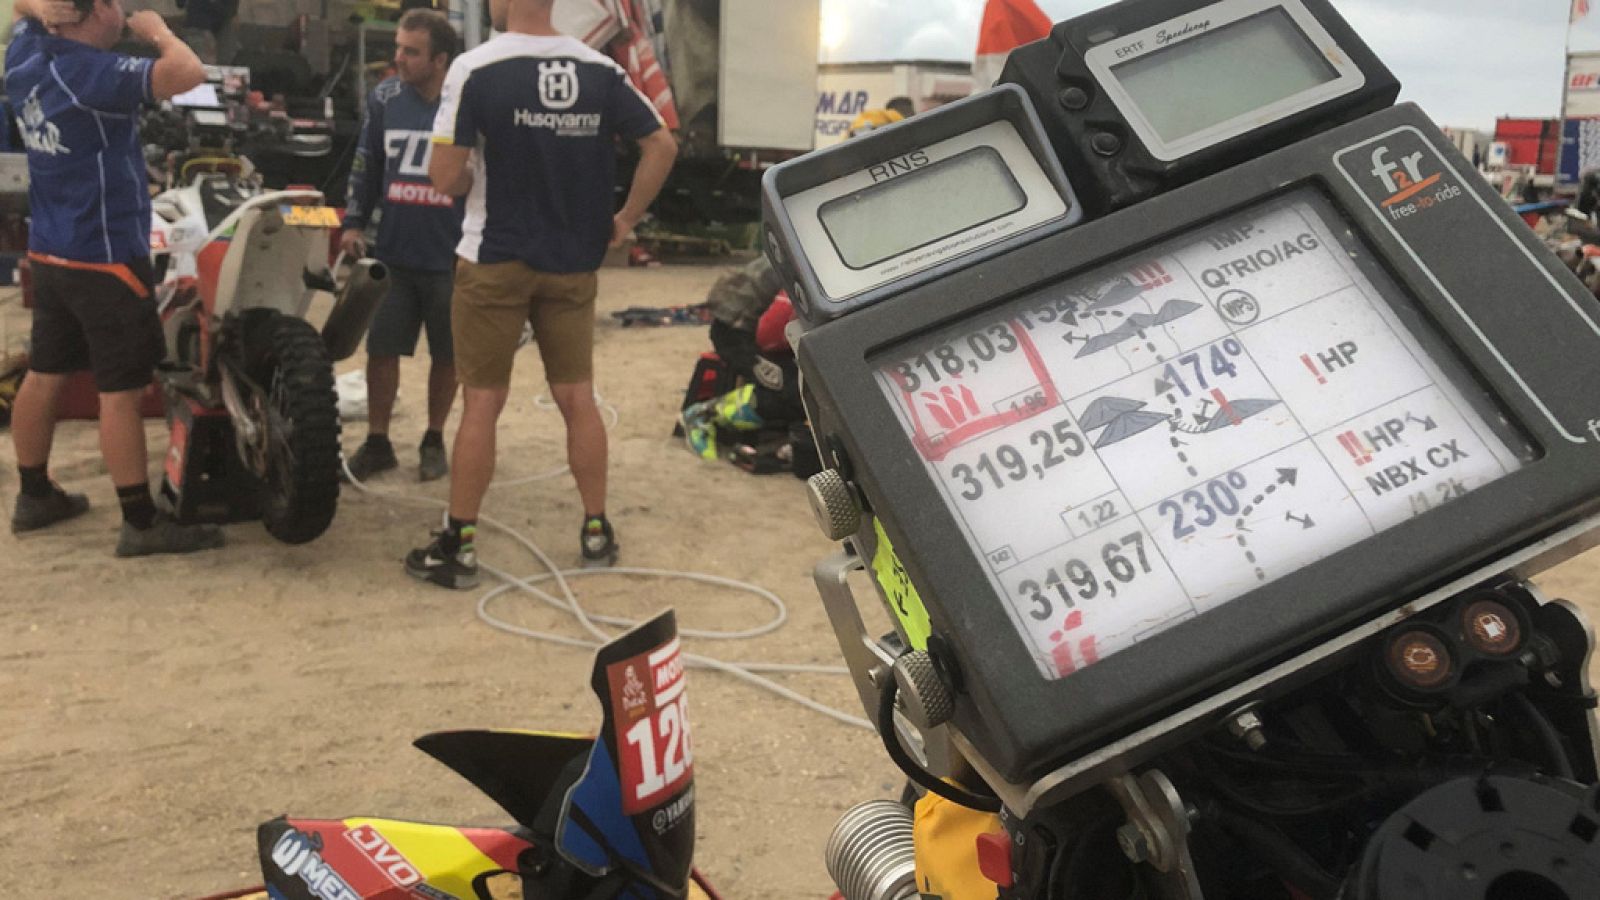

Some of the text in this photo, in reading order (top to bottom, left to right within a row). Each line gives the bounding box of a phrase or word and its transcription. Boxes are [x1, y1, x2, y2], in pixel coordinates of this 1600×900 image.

[1115, 40, 1145, 58] ERTF
[513, 108, 601, 130] Husqvarna
[384, 130, 433, 175] FO
[865, 150, 930, 183] RNS
[1388, 183, 1461, 220] free-to-ride
[896, 324, 1018, 393] 318,03
[951, 419, 1086, 501] 319,25
[1365, 438, 1469, 496] NBX CX
[1077, 500, 1119, 529] 1,22
[1018, 530, 1152, 621] 319,67
[350, 828, 420, 887] JVO
